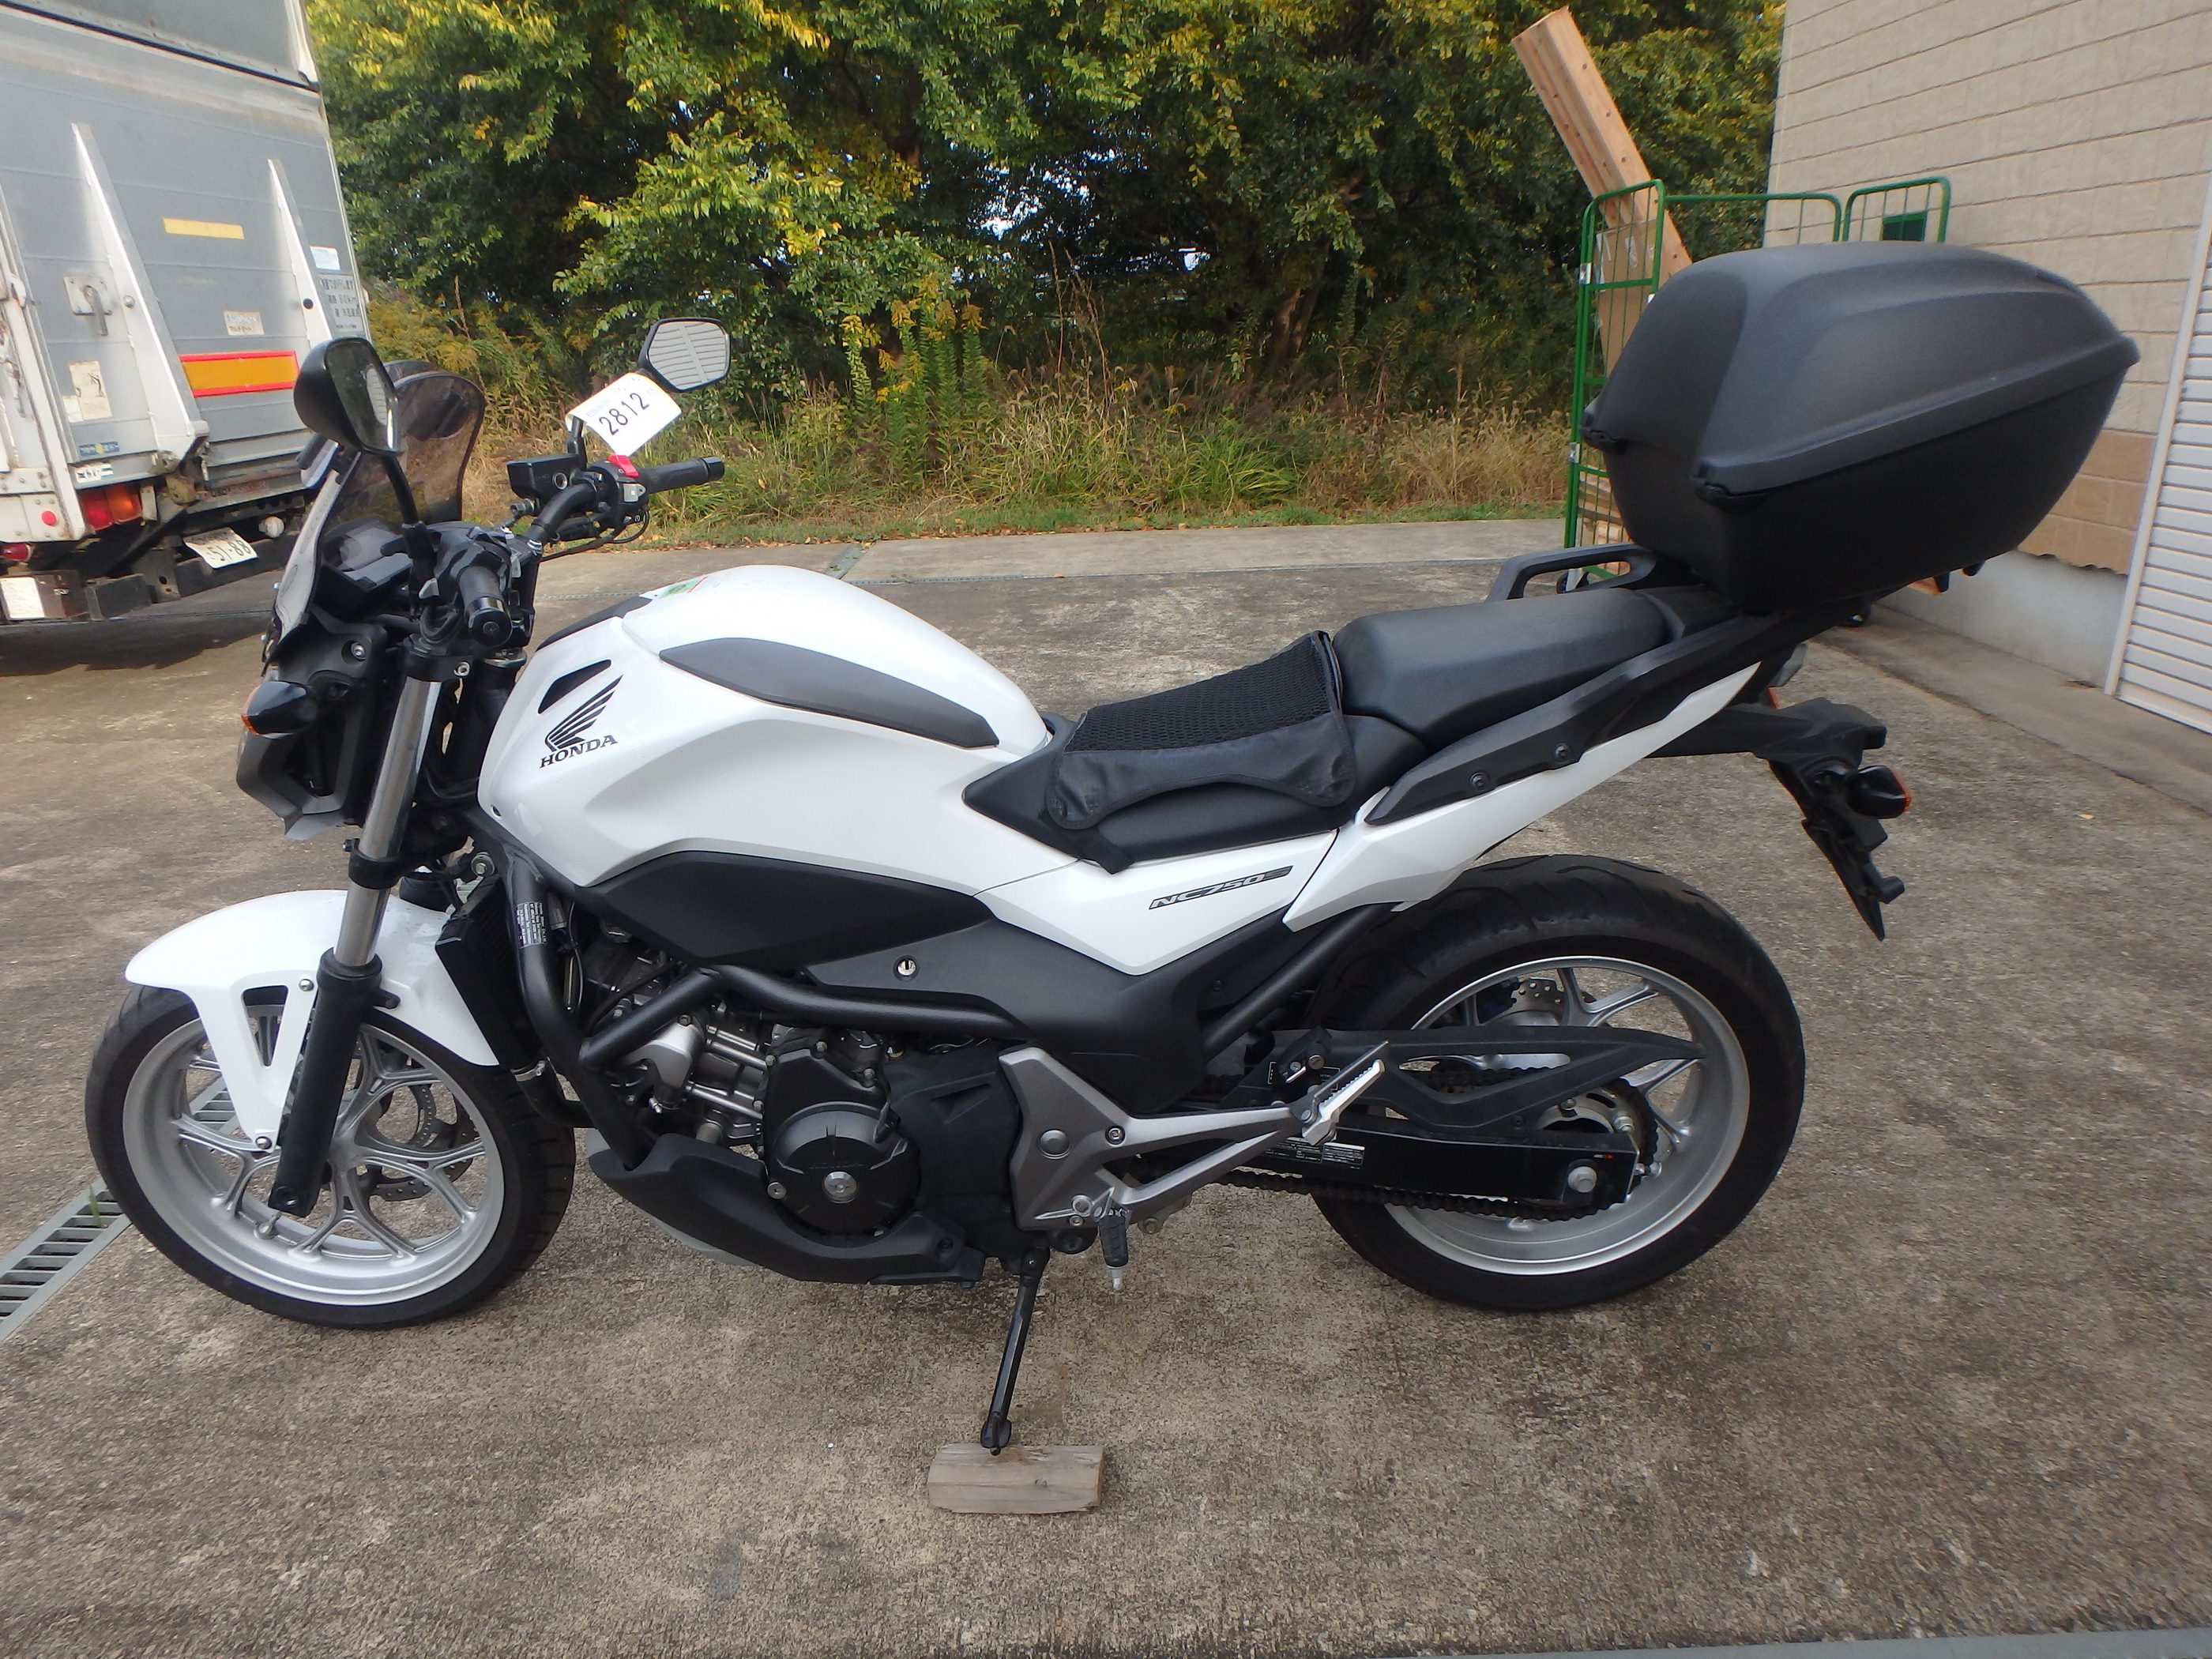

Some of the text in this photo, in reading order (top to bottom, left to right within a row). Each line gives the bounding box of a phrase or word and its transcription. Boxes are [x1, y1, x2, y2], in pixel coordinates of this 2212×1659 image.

[599, 393, 650, 435] 2812
[540, 735, 618, 769] HONDA
[1150, 866, 1291, 908] NC750S
